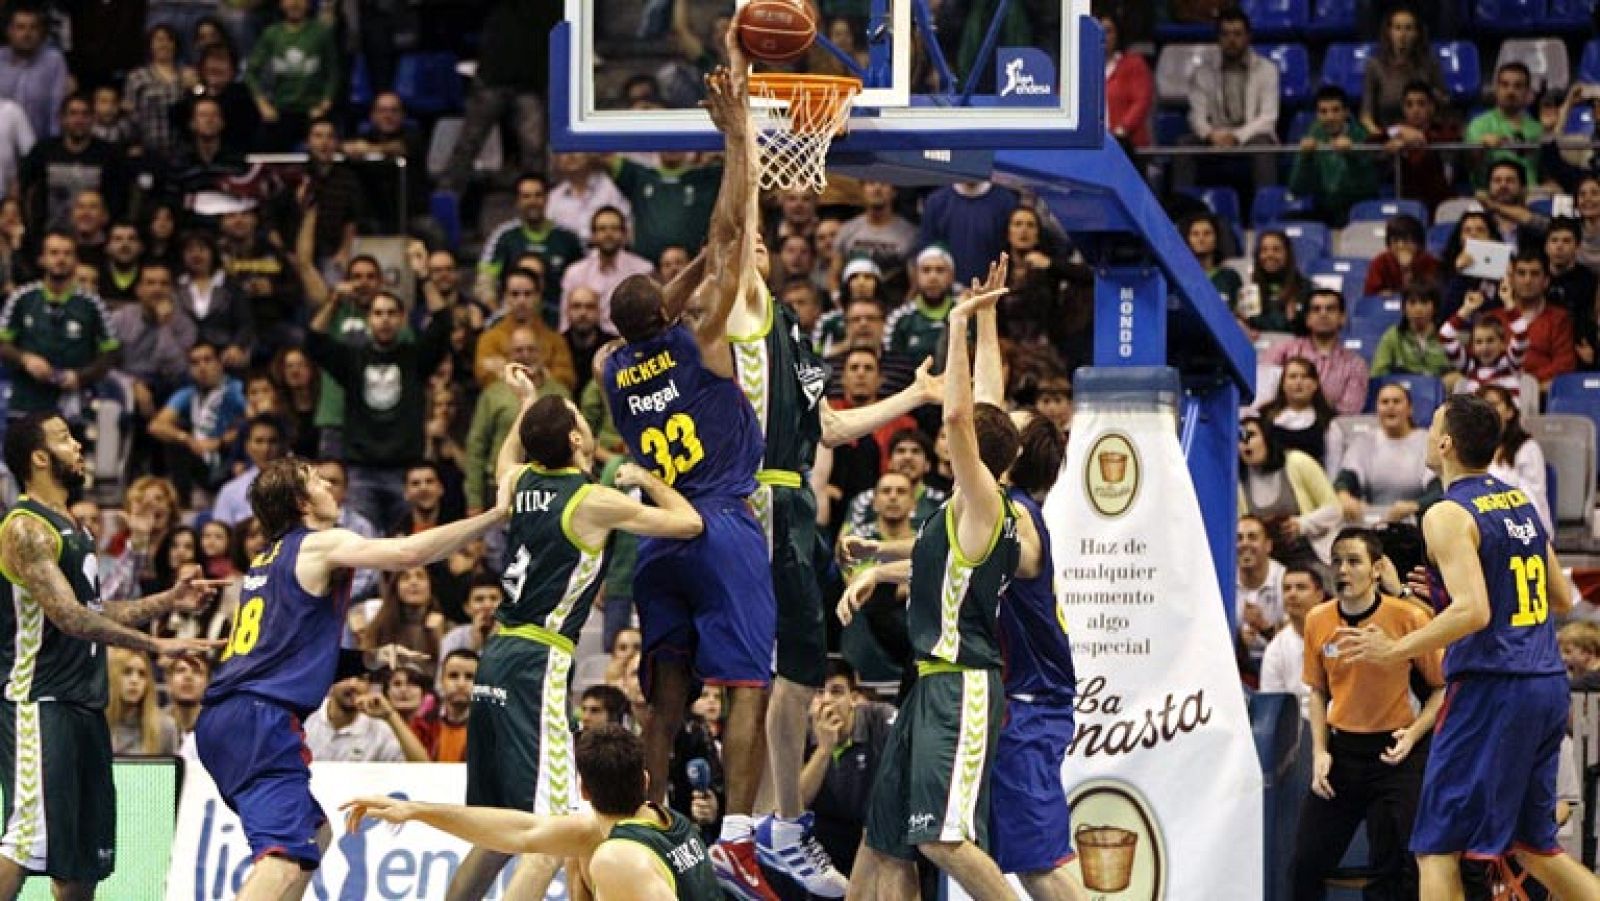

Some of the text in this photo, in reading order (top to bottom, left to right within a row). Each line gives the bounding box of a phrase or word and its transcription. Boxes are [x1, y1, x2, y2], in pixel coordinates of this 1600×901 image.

[1120, 287, 1134, 358] MONDO
[628, 378, 680, 415] Regal
[641, 413, 705, 486] 33
[1080, 538, 1147, 555] Haz de
[1063, 563, 1157, 584] cualquier
[1509, 554, 1549, 627] 13
[1065, 590, 1155, 604] momento
[1086, 612, 1130, 632] algo
[1071, 638, 1151, 658] especial
[1075, 675, 1123, 715] La
[1067, 688, 1213, 757] nasta
